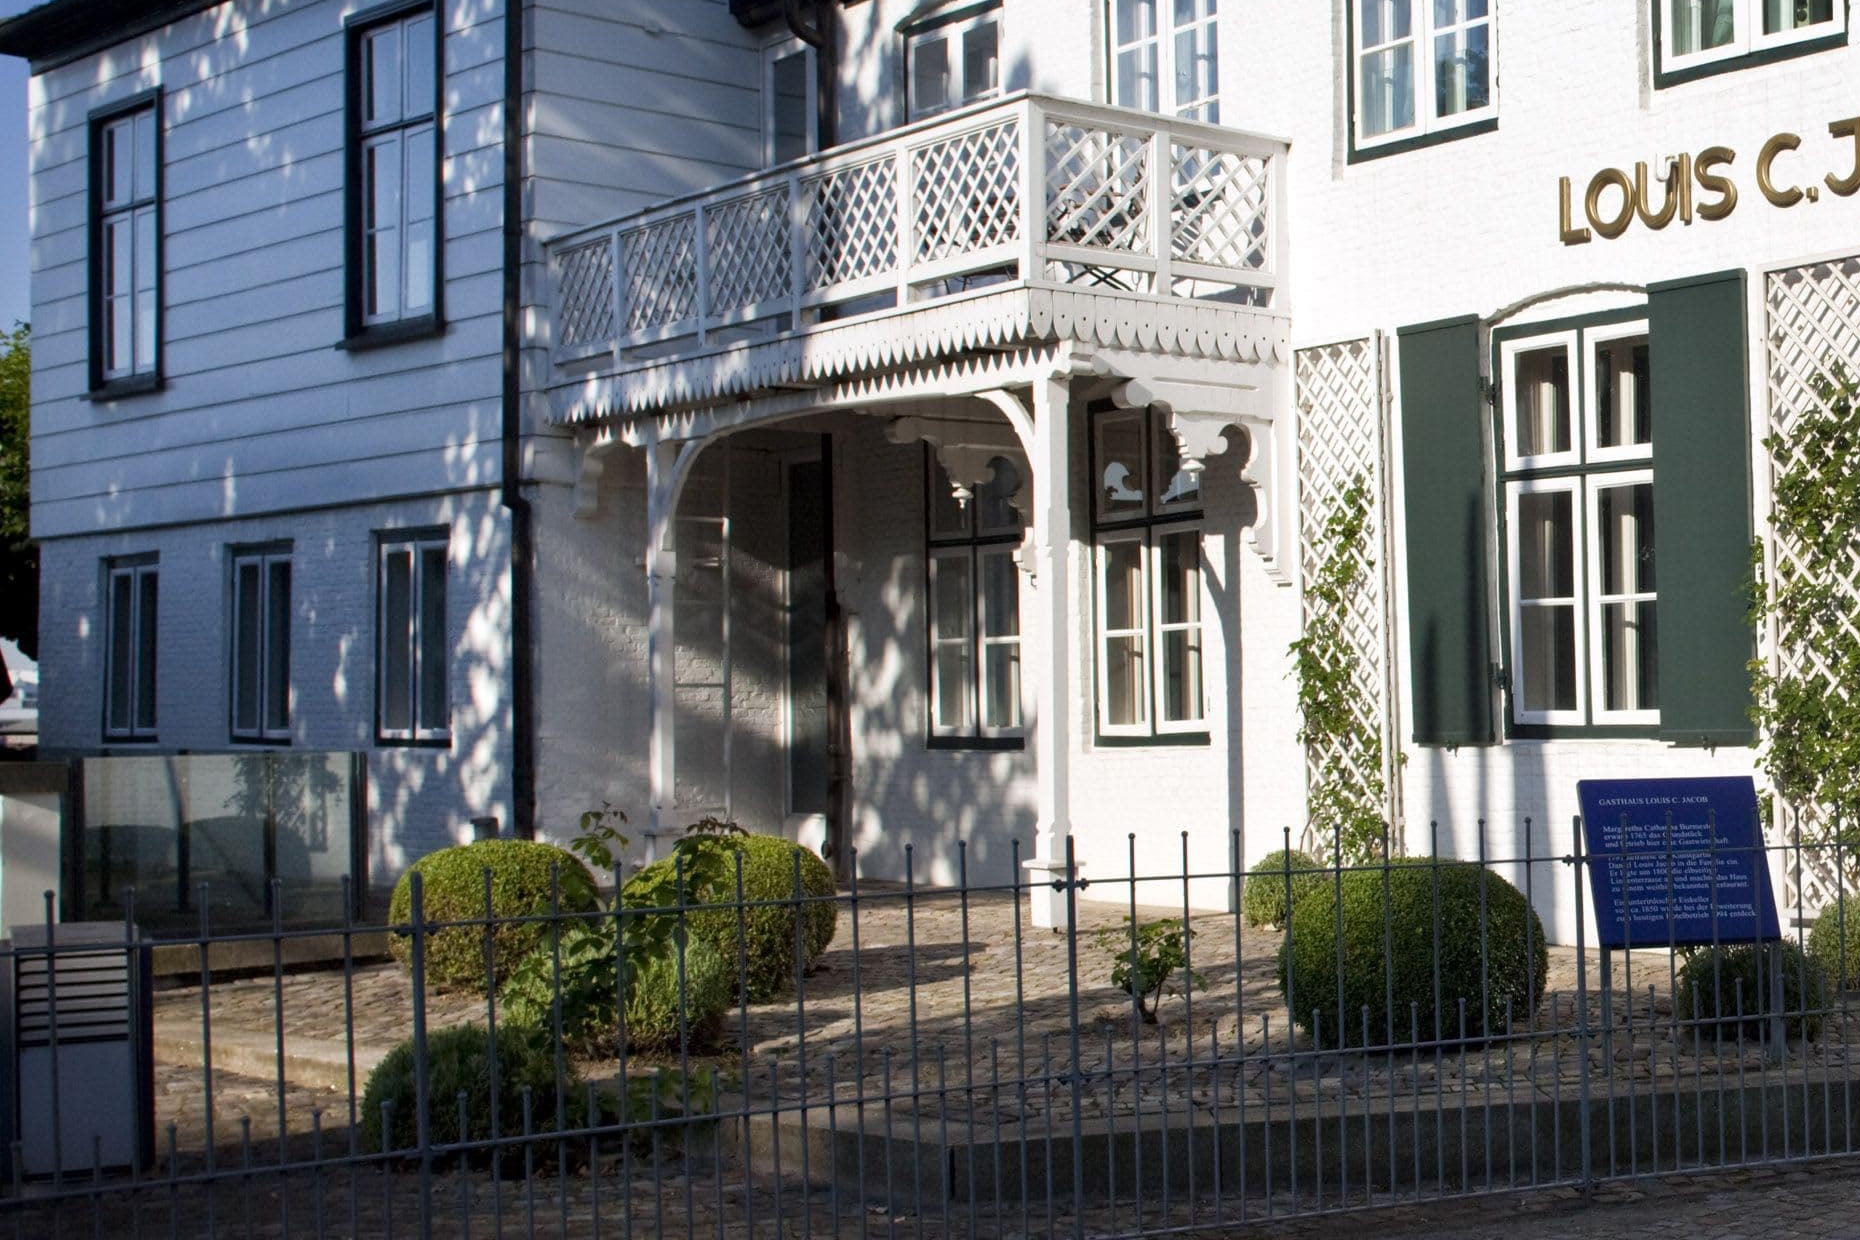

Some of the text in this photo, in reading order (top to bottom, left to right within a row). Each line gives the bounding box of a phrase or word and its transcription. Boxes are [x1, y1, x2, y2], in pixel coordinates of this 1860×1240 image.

[1558, 145, 1738, 245] LOUIS
[1598, 798, 1644, 806] GASTHAUS
[1644, 797, 1671, 805] LOUIS
[1682, 796, 1709, 804] JACOB
